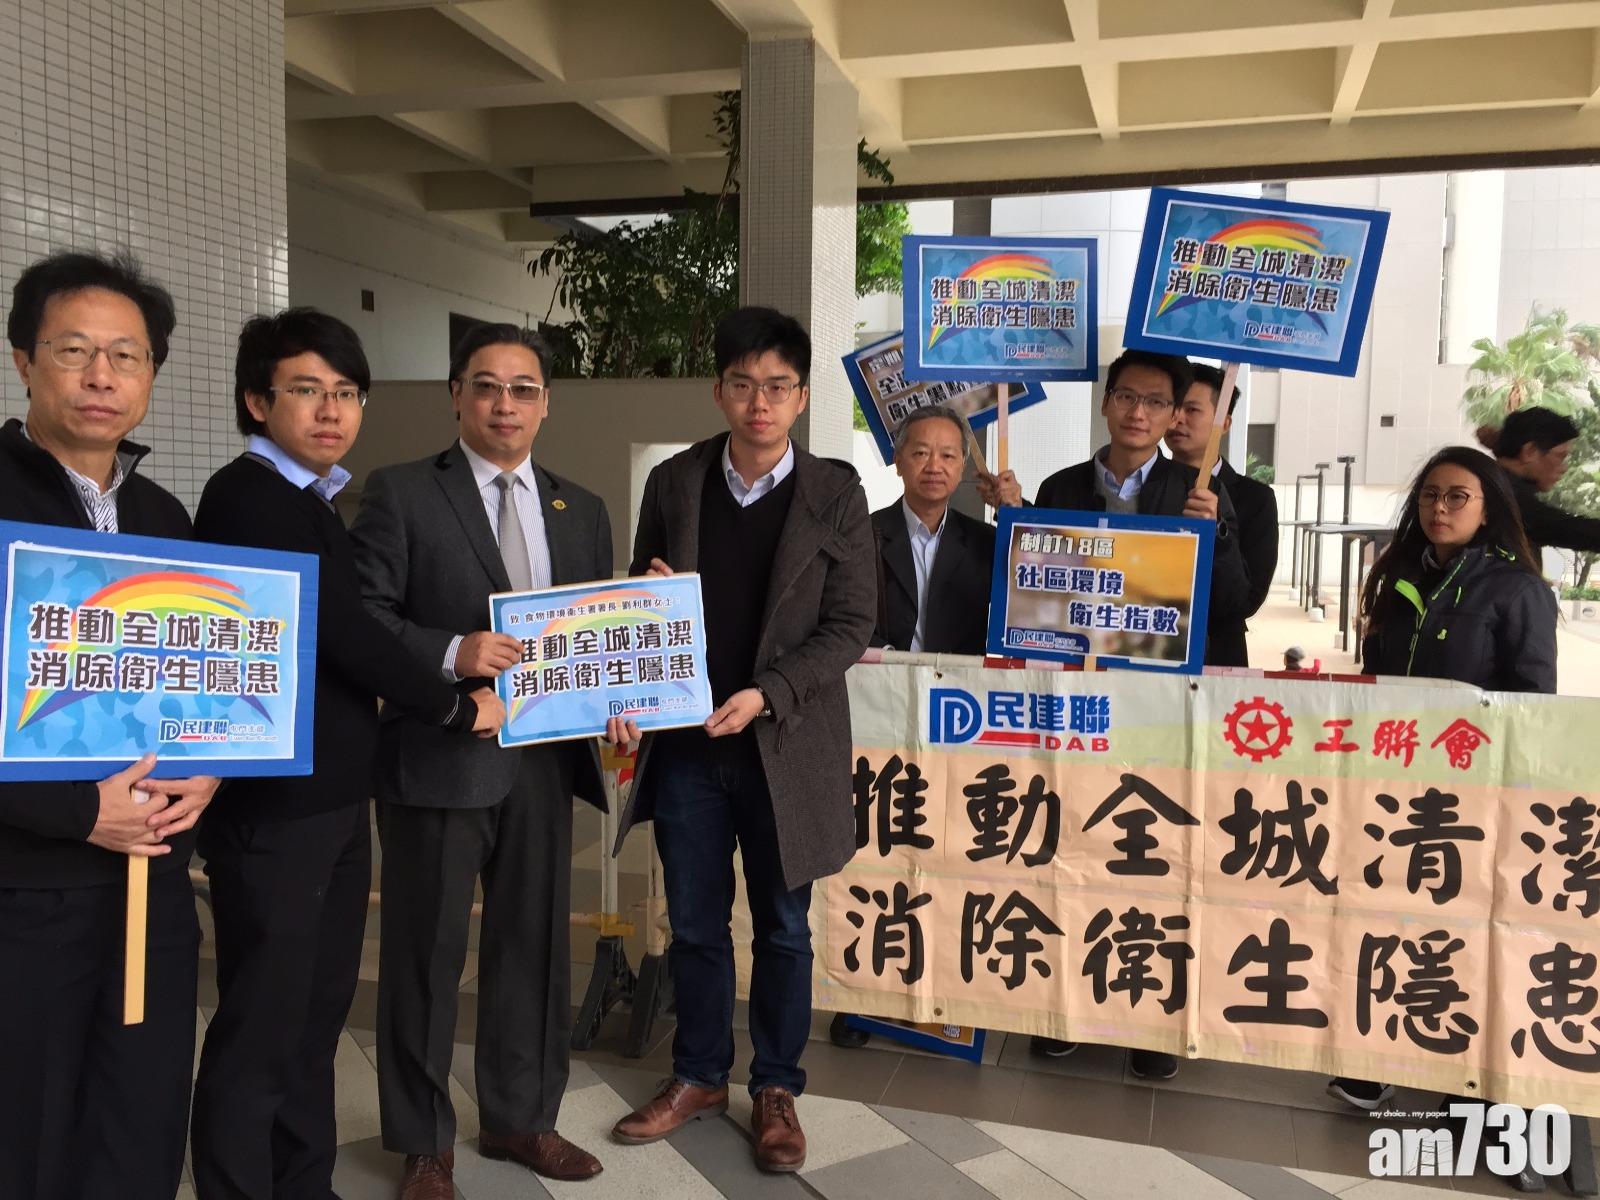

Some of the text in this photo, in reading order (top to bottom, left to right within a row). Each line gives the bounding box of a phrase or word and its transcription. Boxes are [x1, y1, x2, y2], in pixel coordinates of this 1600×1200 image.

[1173, 239, 1345, 281] 推動全城清潔
[932, 278, 1075, 302] 推動全城清潔
[1167, 270, 1338, 312] 消除衛生隱患
[932, 305, 1075, 328] 消除衛生隱患
[1020, 533, 1114, 558] 制訂18區
[1016, 565, 1123, 596] 社區環境
[30, 604, 279, 652] 推動全城清潔
[1069, 603, 1179, 635] 衛生指數
[28, 651, 279, 694] 消除衛生隱患
[513, 654, 695, 698] 消除衛生隱患
[988, 691, 1110, 735] 民建聯
[1045, 738, 1110, 752] DAB
[1313, 716, 1491, 770] 工聯會
[843, 882, 1600, 1074] 消除衛生隱患
